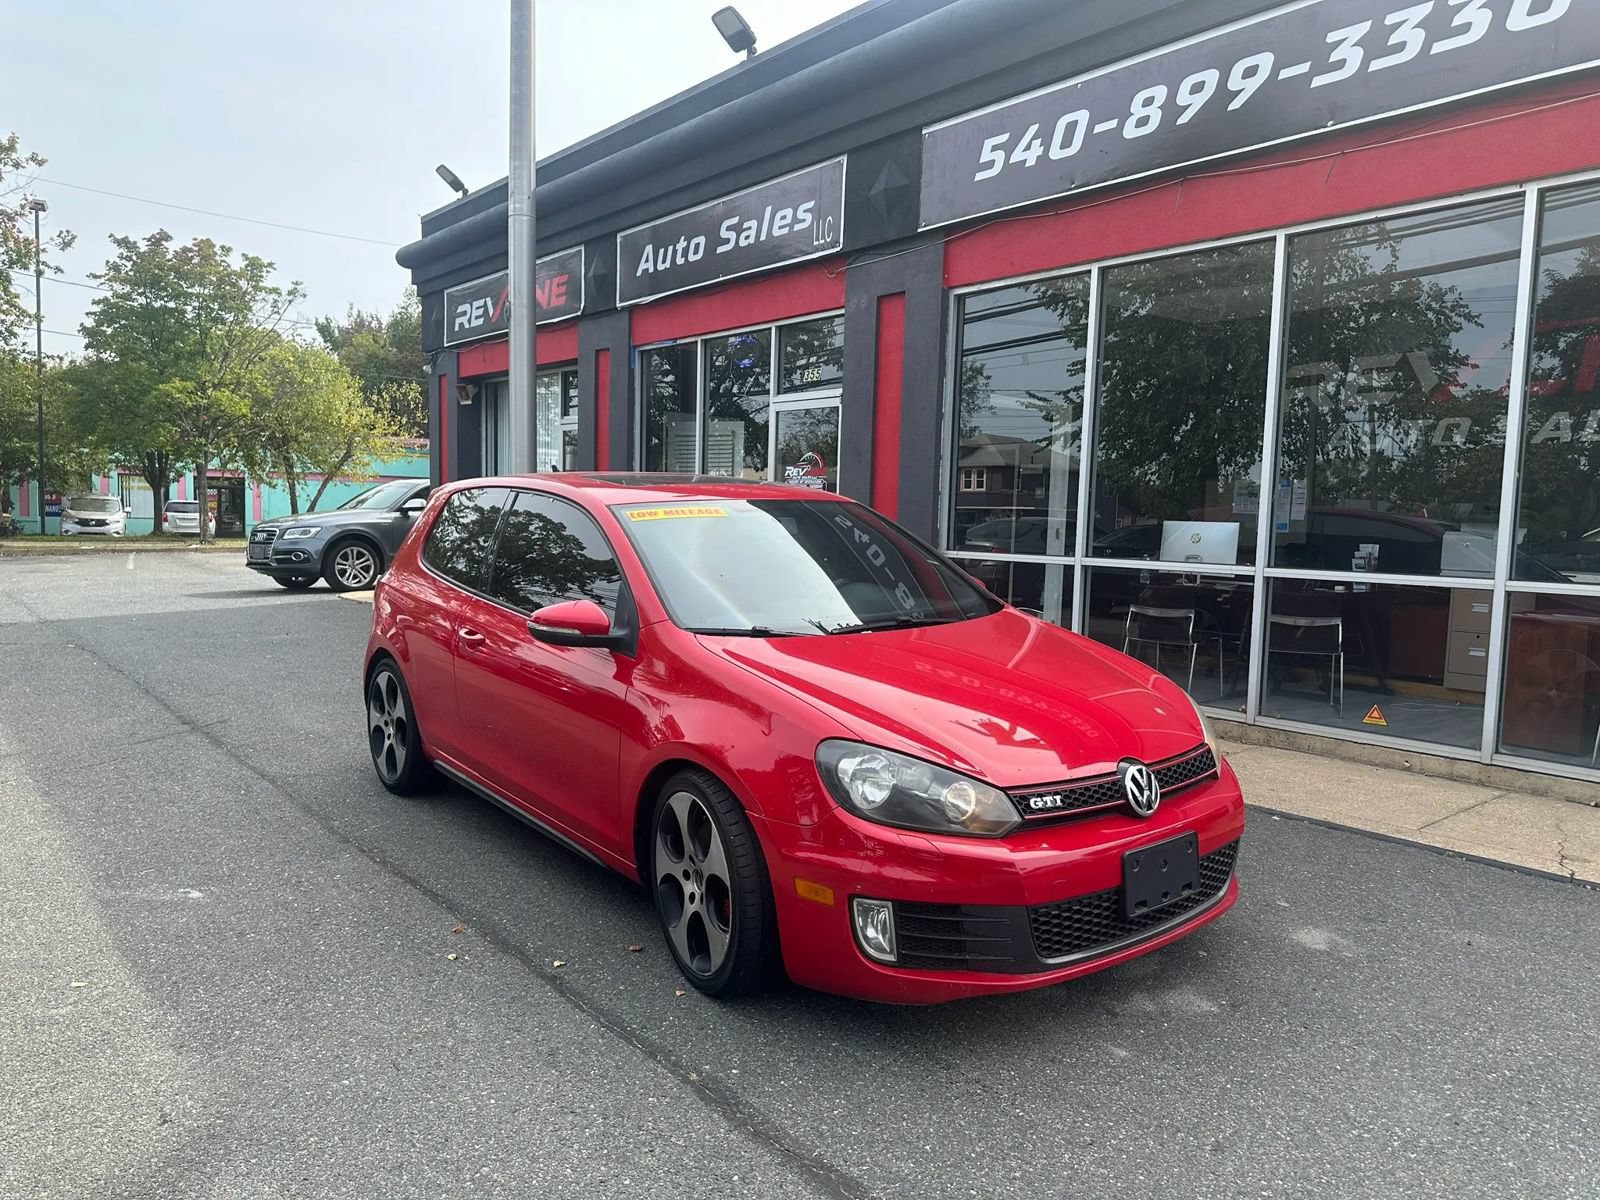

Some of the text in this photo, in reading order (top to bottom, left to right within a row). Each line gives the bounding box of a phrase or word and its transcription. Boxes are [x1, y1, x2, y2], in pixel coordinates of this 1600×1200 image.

[635, 200, 834, 277] Auto Sales LLC
[629, 508, 724, 519] LOW MILEAGE
[1029, 795, 1064, 810] GTI
